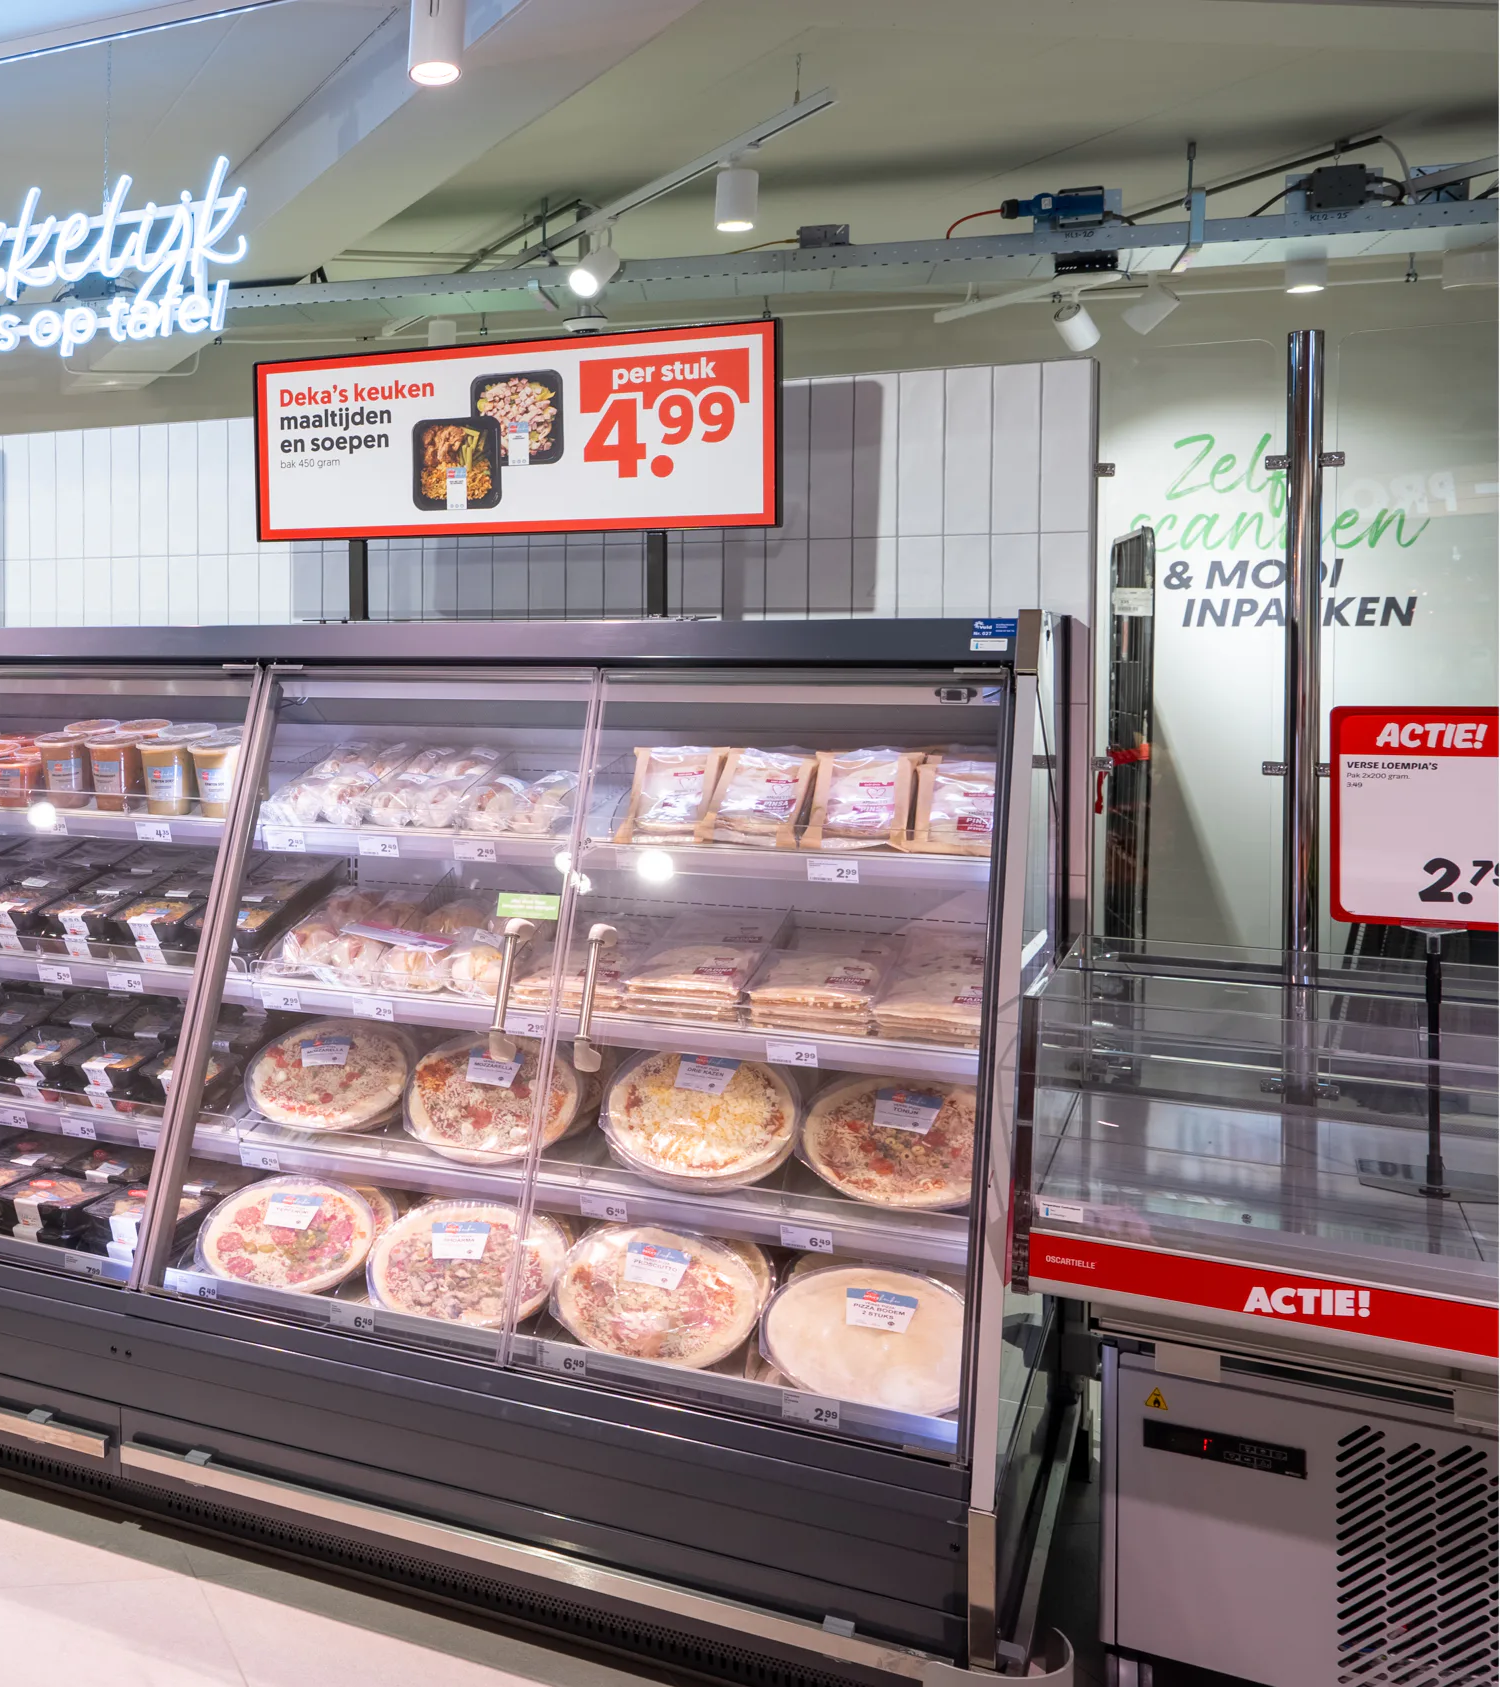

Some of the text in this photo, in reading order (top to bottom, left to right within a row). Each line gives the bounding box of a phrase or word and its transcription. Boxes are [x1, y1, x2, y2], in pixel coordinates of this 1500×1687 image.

[28, 308, 98, 357] op
[108, 279, 231, 344] tafel
[612, 357, 717, 390] per stuk
[279, 379, 435, 408] Deka's keuken
[279, 406, 392, 434] maaltijden
[583, 390, 736, 479] 4.99
[280, 431, 390, 457] en soepen
[280, 458, 341, 471] bak 450 gram
[1129, 508, 1431, 553] scanen
[1163, 561, 1193, 590] &
[1182, 596, 1418, 628] INPAKEN
[1376, 722, 1488, 749] ACTIE!
[1346, 760, 1438, 772] VERSE LOEMPIA'S
[1361, 772, 1385, 780] 2x200
[381, 843, 397, 854] 2.49
[477, 848, 494, 859] 2.49
[836, 867, 857, 881] 2.99
[127, 979, 141, 989] 5.49
[376, 1007, 392, 1018] 2.99
[795, 1050, 817, 1064] 2.99
[474, 1062, 513, 1072] MOZZARELLA
[687, 1066, 702, 1074] DRIE
[893, 1107, 919, 1115] TONIJN
[605, 1205, 626, 1218] 6.49
[809, 1236, 831, 1249] 6.49
[1045, 1254, 1096, 1270] OSCARTIELLE
[198, 1286, 216, 1298] 6.49
[853, 1302, 906, 1316] PIZZA BODEM
[1243, 1286, 1371, 1318] ACTIE!
[353, 1315, 373, 1330] 6.49
[868, 1312, 895, 1320] STUKS
[563, 1357, 584, 1372] 6.49
[813, 1407, 838, 1423] 2.99
